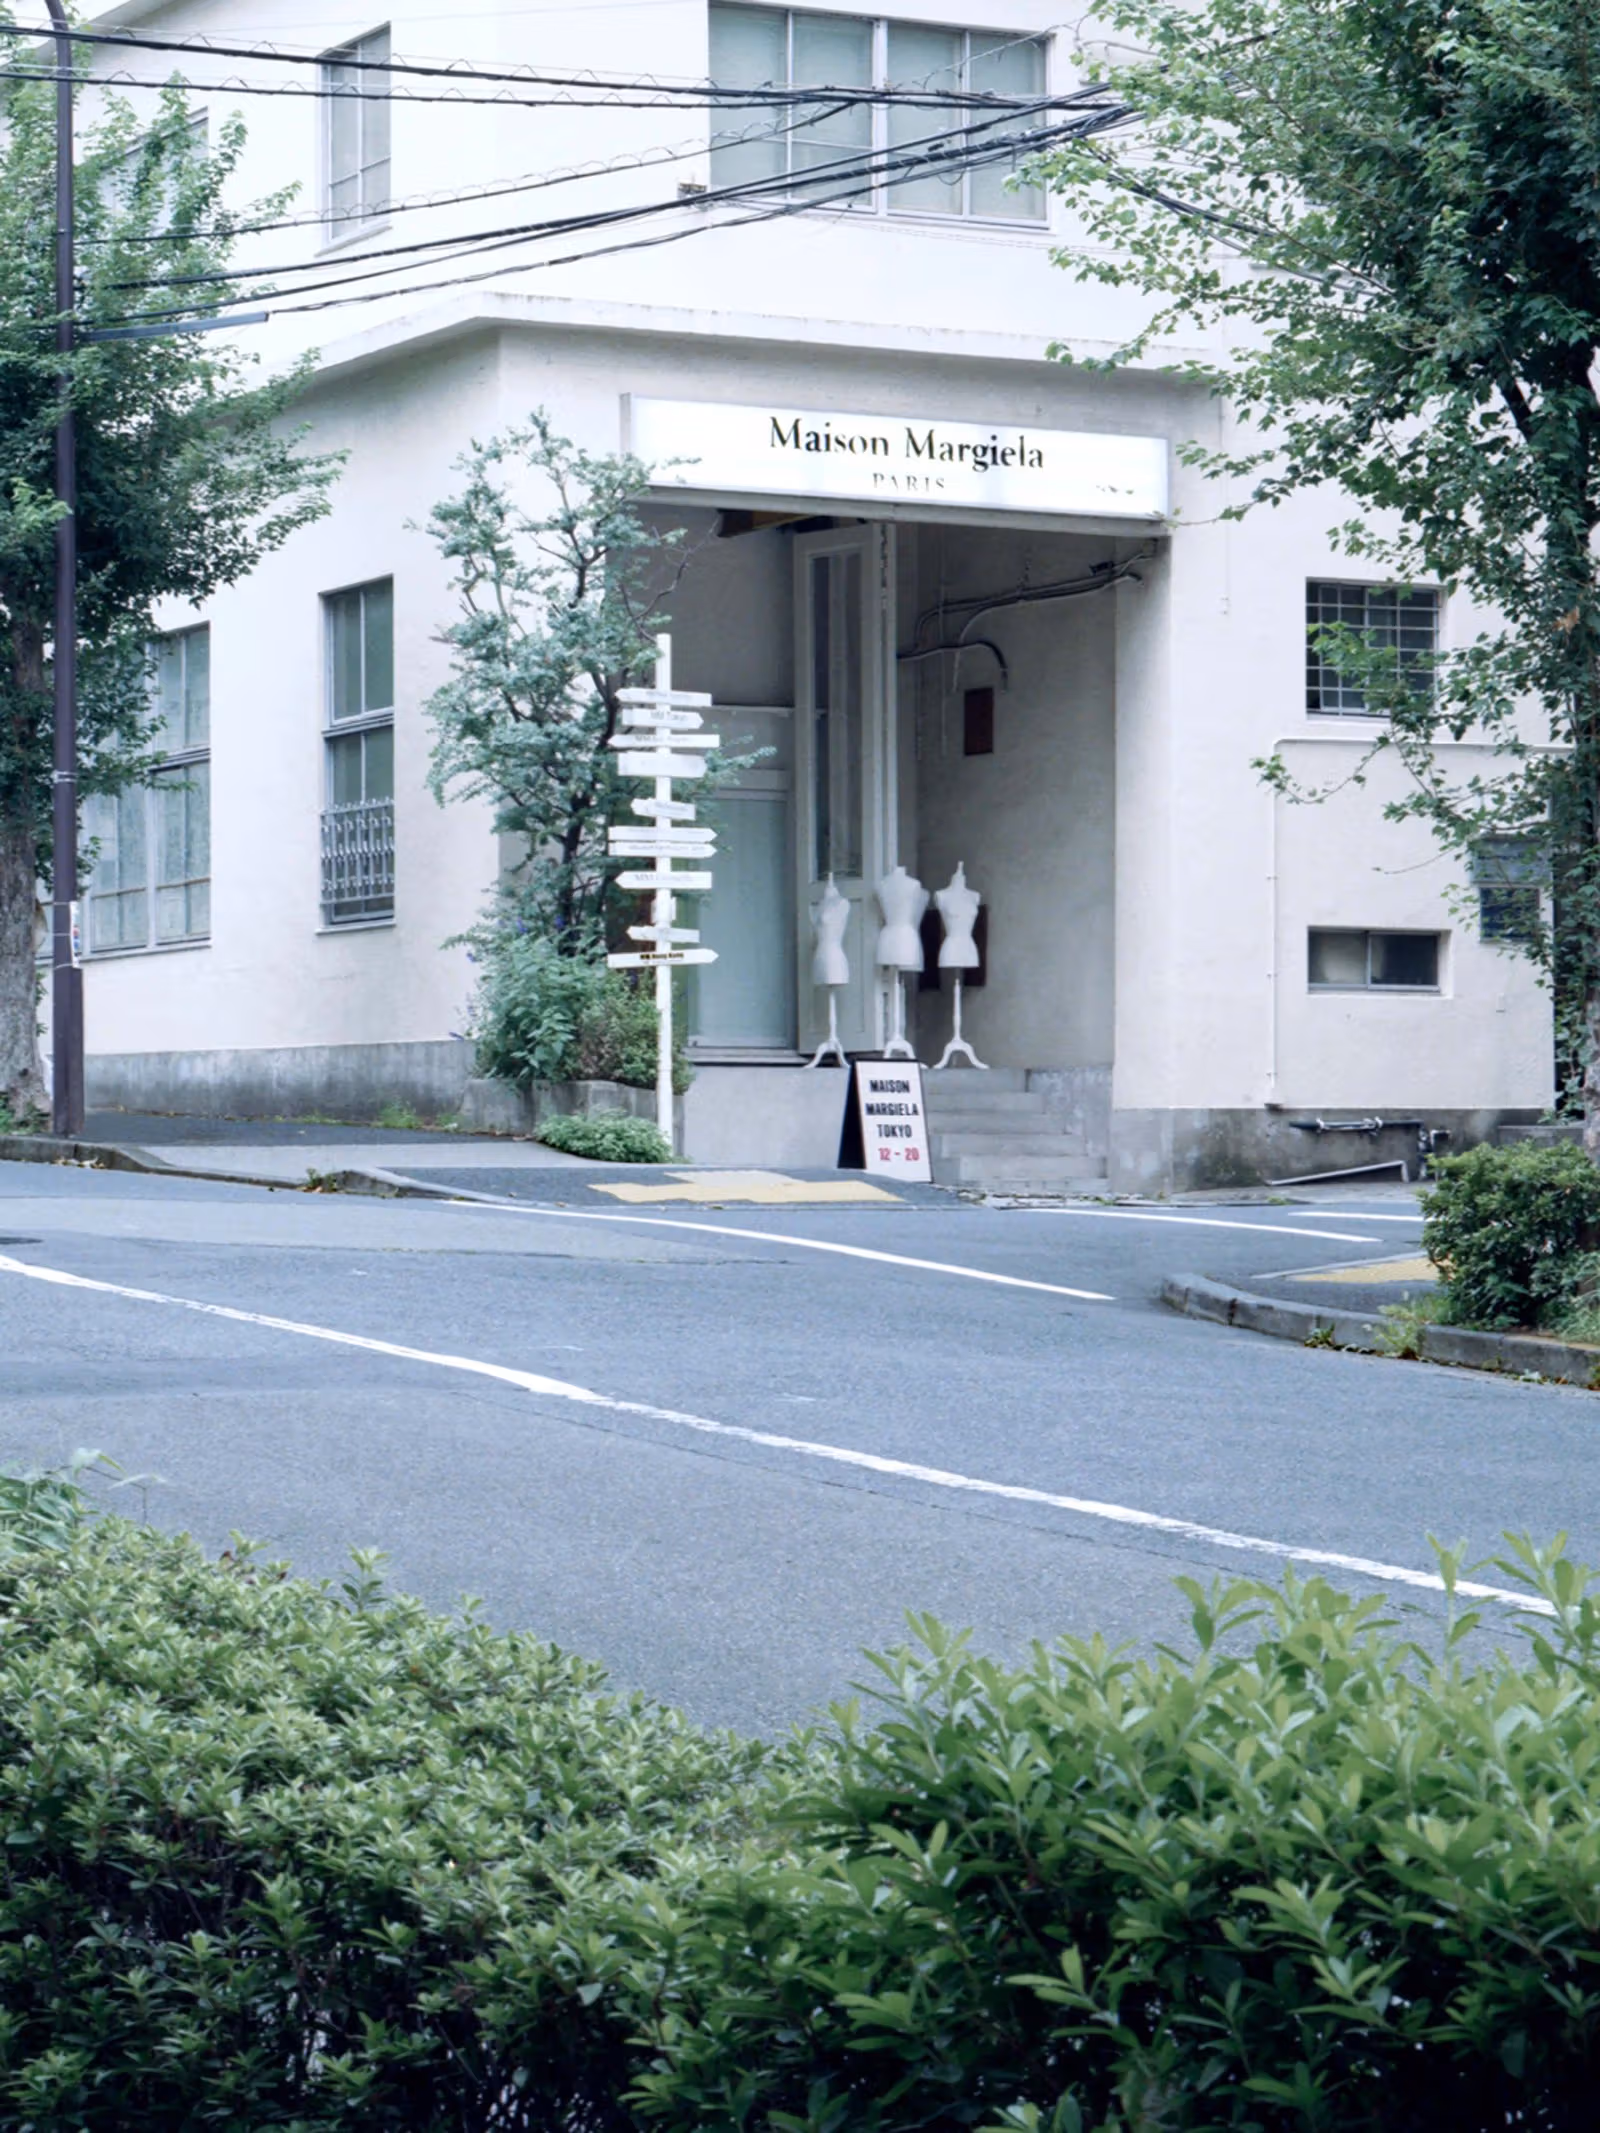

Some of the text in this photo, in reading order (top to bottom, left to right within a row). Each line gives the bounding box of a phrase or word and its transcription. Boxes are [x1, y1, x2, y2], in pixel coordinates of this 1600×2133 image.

[770, 416, 1044, 473] Maison Margiela
[873, 472, 945, 492] PARIS
[870, 1079, 910, 1093] MAISON
[865, 1103, 919, 1116] MARGIELA
[877, 1124, 912, 1138] TOKYO
[878, 1147, 891, 1161] 12
[904, 1147, 920, 1161] 20
